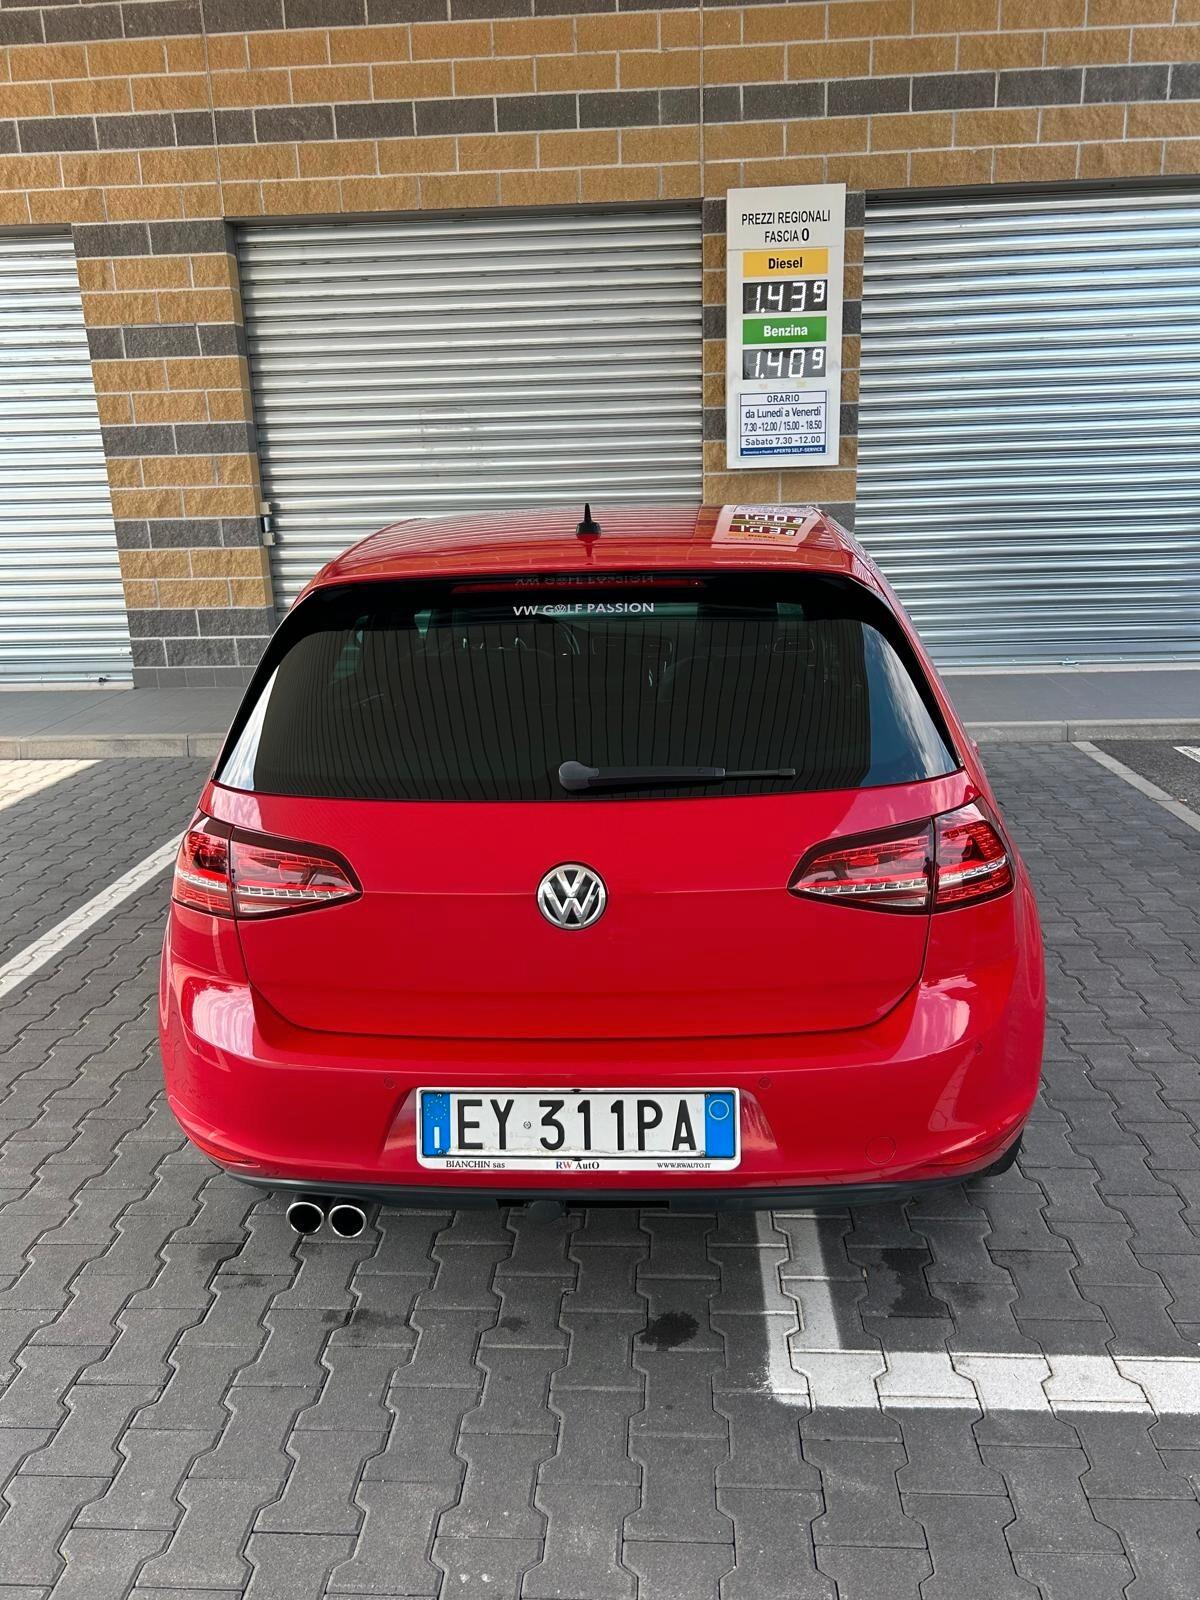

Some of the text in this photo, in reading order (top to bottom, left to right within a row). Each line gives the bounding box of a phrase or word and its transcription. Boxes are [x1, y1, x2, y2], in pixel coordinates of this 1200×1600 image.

[741, 209, 831, 225] PREZZI REGIONALI
[764, 229, 800, 243] FASCIA
[768, 256, 803, 270] Diesel
[755, 280, 826, 313] 1.439
[763, 324, 808, 337] Benzina
[755, 348, 824, 379] 1.409
[766, 394, 800, 403] ORARIO
[745, 409, 755, 419] da
[744, 422, 757, 432] 7.30
[783, 420, 800, 431] 15.00
[806, 419, 823, 430] 18.50
[745, 437, 773, 446] Sabato
[775, 436, 793, 445] 7.30
[512, 602, 655, 616] VW GOLF PASSION
[538, 863, 606, 930] VW
[457, 1099, 697, 1151] EY 311PA
[446, 1160, 506, 1169] BIANCHIN sas
[555, 1161, 572, 1170] RW
